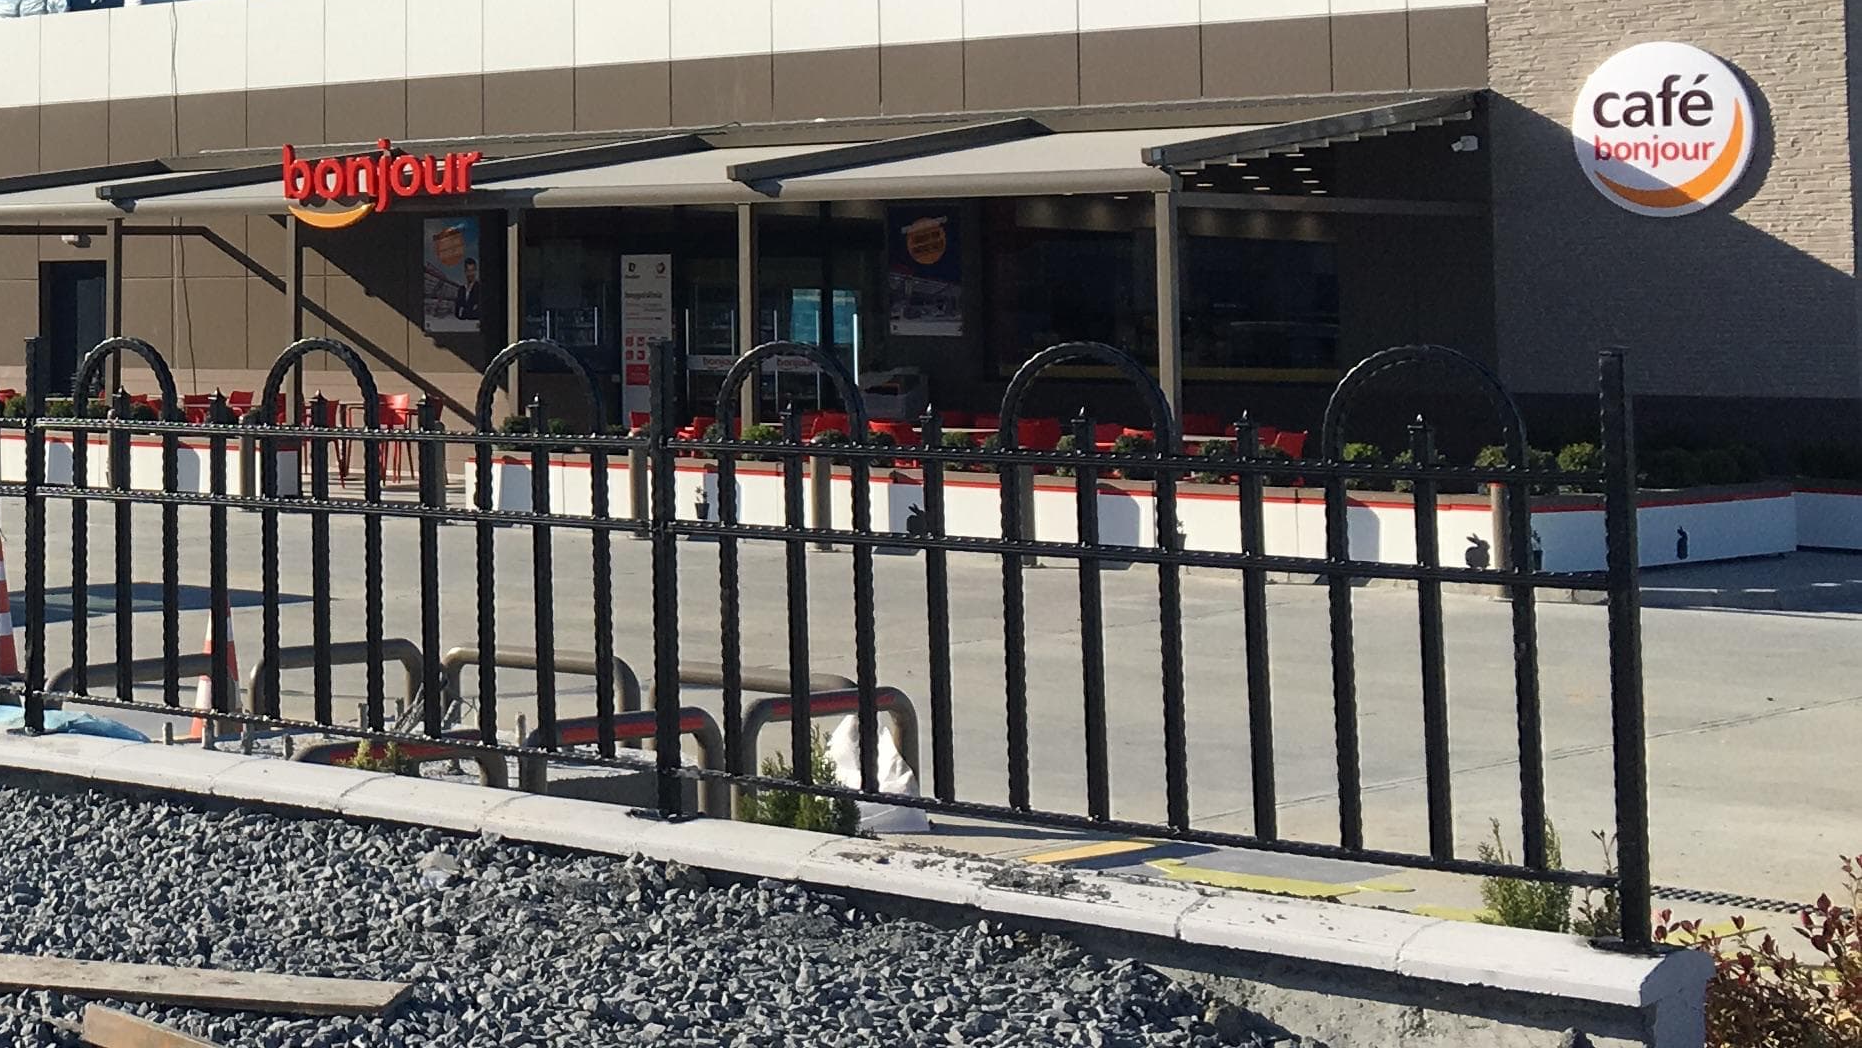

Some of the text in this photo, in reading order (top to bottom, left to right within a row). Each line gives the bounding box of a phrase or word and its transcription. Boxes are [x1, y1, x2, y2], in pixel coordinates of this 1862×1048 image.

[1592, 73, 1714, 129] café
[283, 138, 482, 212] bonjour
[1594, 135, 1715, 168] bonjour
